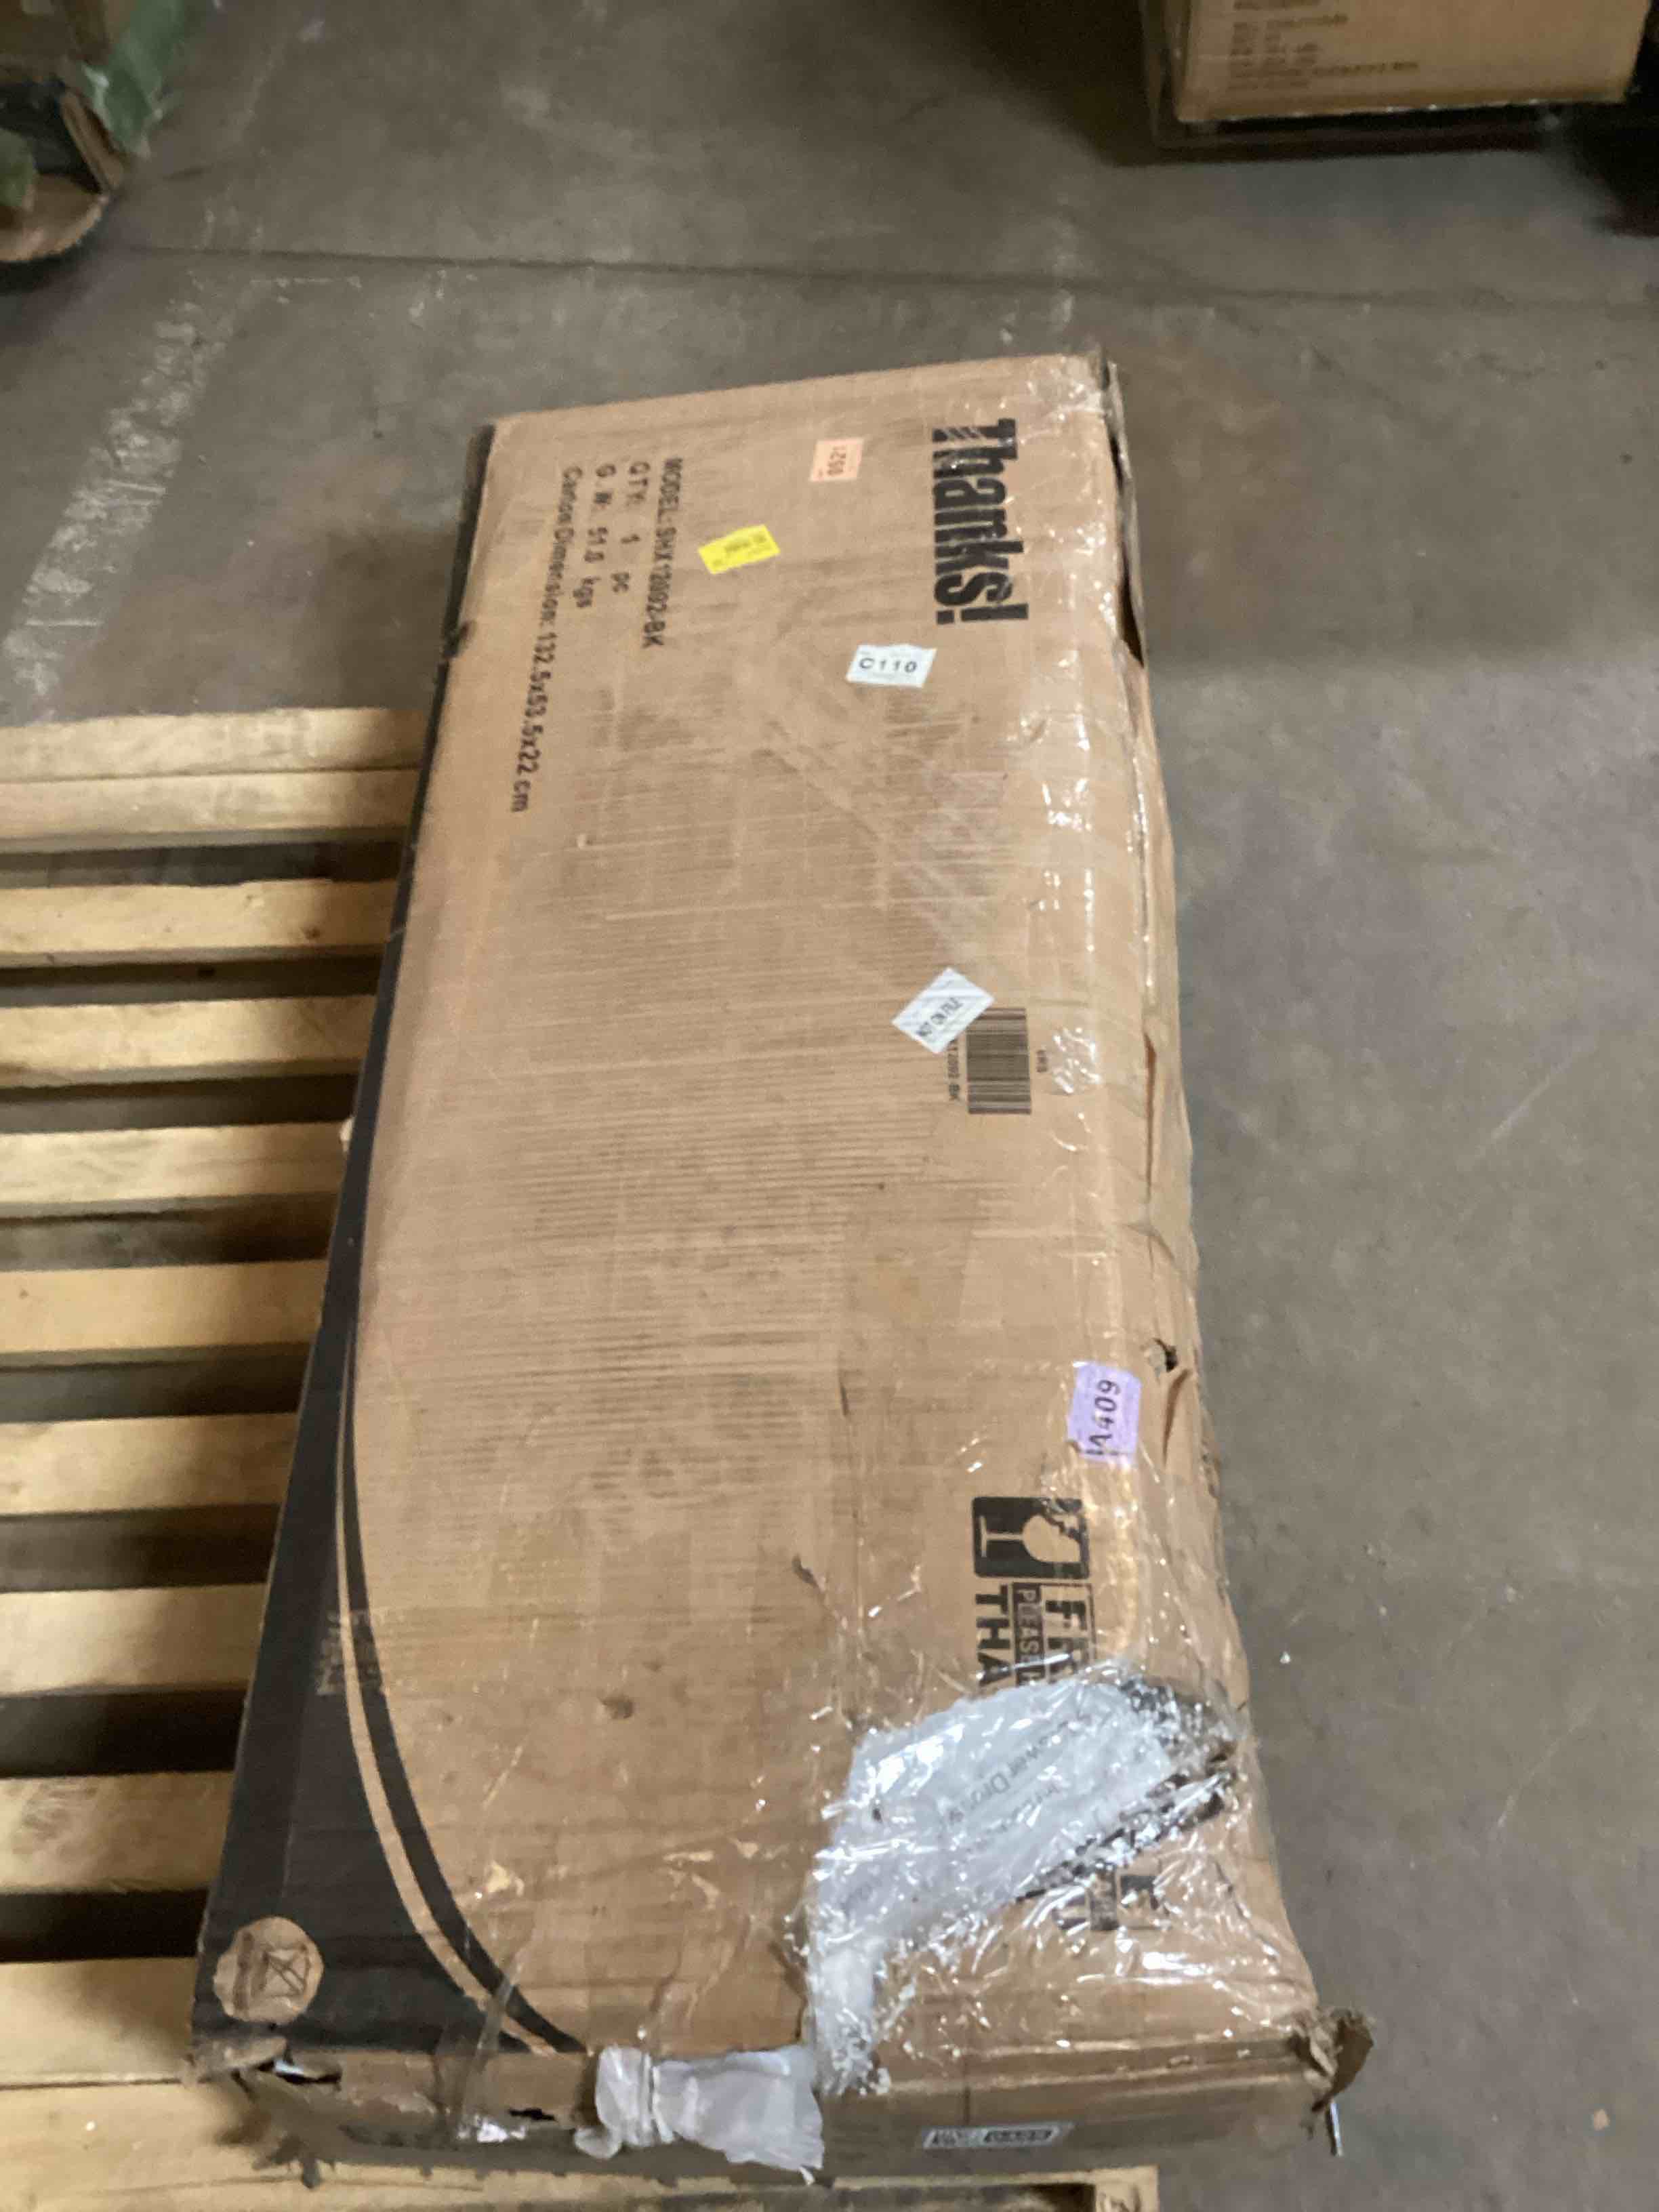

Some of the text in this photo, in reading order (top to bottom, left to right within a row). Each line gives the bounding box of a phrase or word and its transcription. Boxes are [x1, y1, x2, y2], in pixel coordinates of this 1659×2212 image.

[931, 417, 1029, 626] Thanks!
[859, 657, 918, 673] C110
[975, 1584, 1010, 1687] THA
